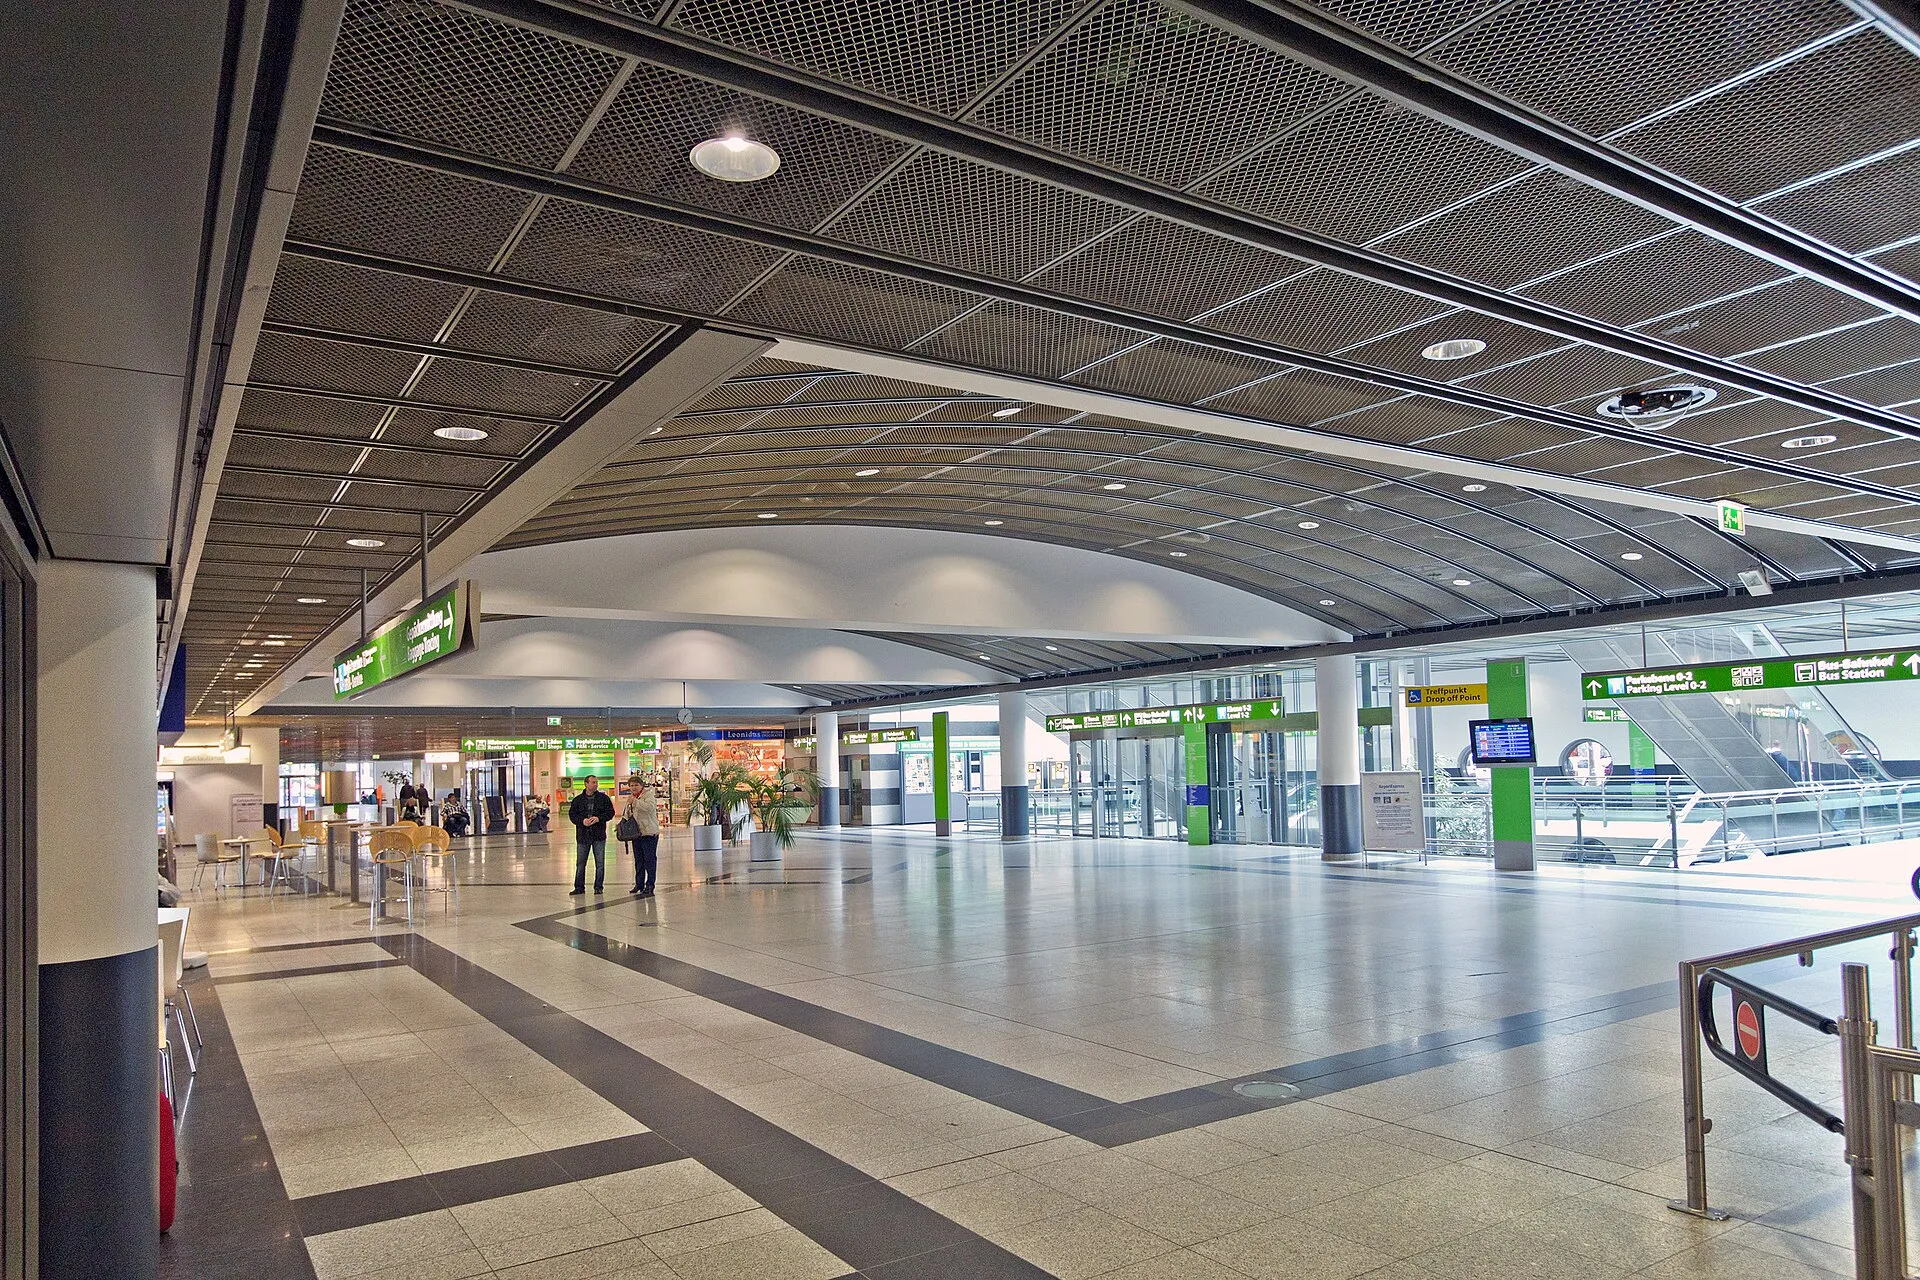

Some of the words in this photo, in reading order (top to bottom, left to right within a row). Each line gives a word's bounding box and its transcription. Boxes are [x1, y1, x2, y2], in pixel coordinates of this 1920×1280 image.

[1817, 654, 1896, 670] Bus-Bahnhof
[1625, 674, 1675, 685] Parkebene
[1676, 671, 1693, 681] 0-2
[1818, 671, 1840, 681] Bus
[1841, 668, 1885, 680] Station
[1426, 687, 1467, 696] Treffpunkt
[1627, 684, 1662, 694] Parking
[1663, 681, 1690, 692] Level
[1690, 680, 1707, 690] 0-2
[1426, 695, 1446, 703] Drop
[1447, 694, 1459, 702] off
